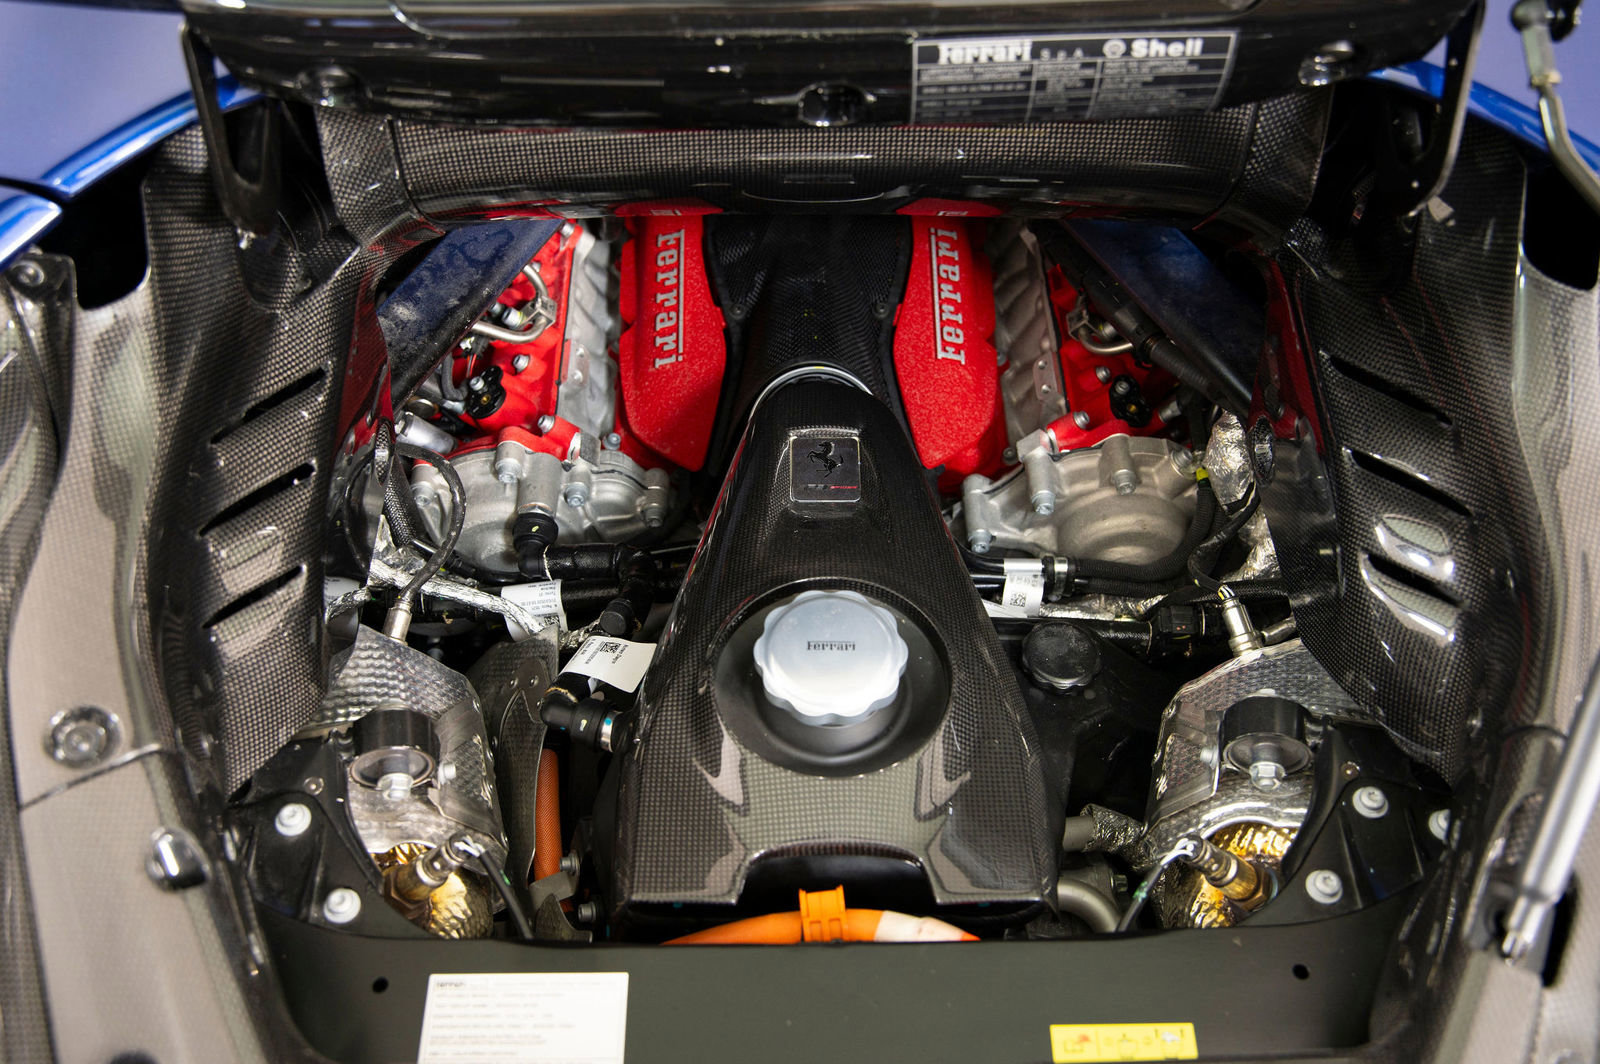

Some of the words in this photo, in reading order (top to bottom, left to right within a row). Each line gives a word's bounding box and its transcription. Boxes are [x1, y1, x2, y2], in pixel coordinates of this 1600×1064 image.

[938, 40, 1032, 65] Ferrari
[1131, 38, 1204, 58] Shell
[655, 229, 685, 369] Ferrari
[930, 227, 965, 365] Ferrari
[807, 641, 856, 651] Ferrari
